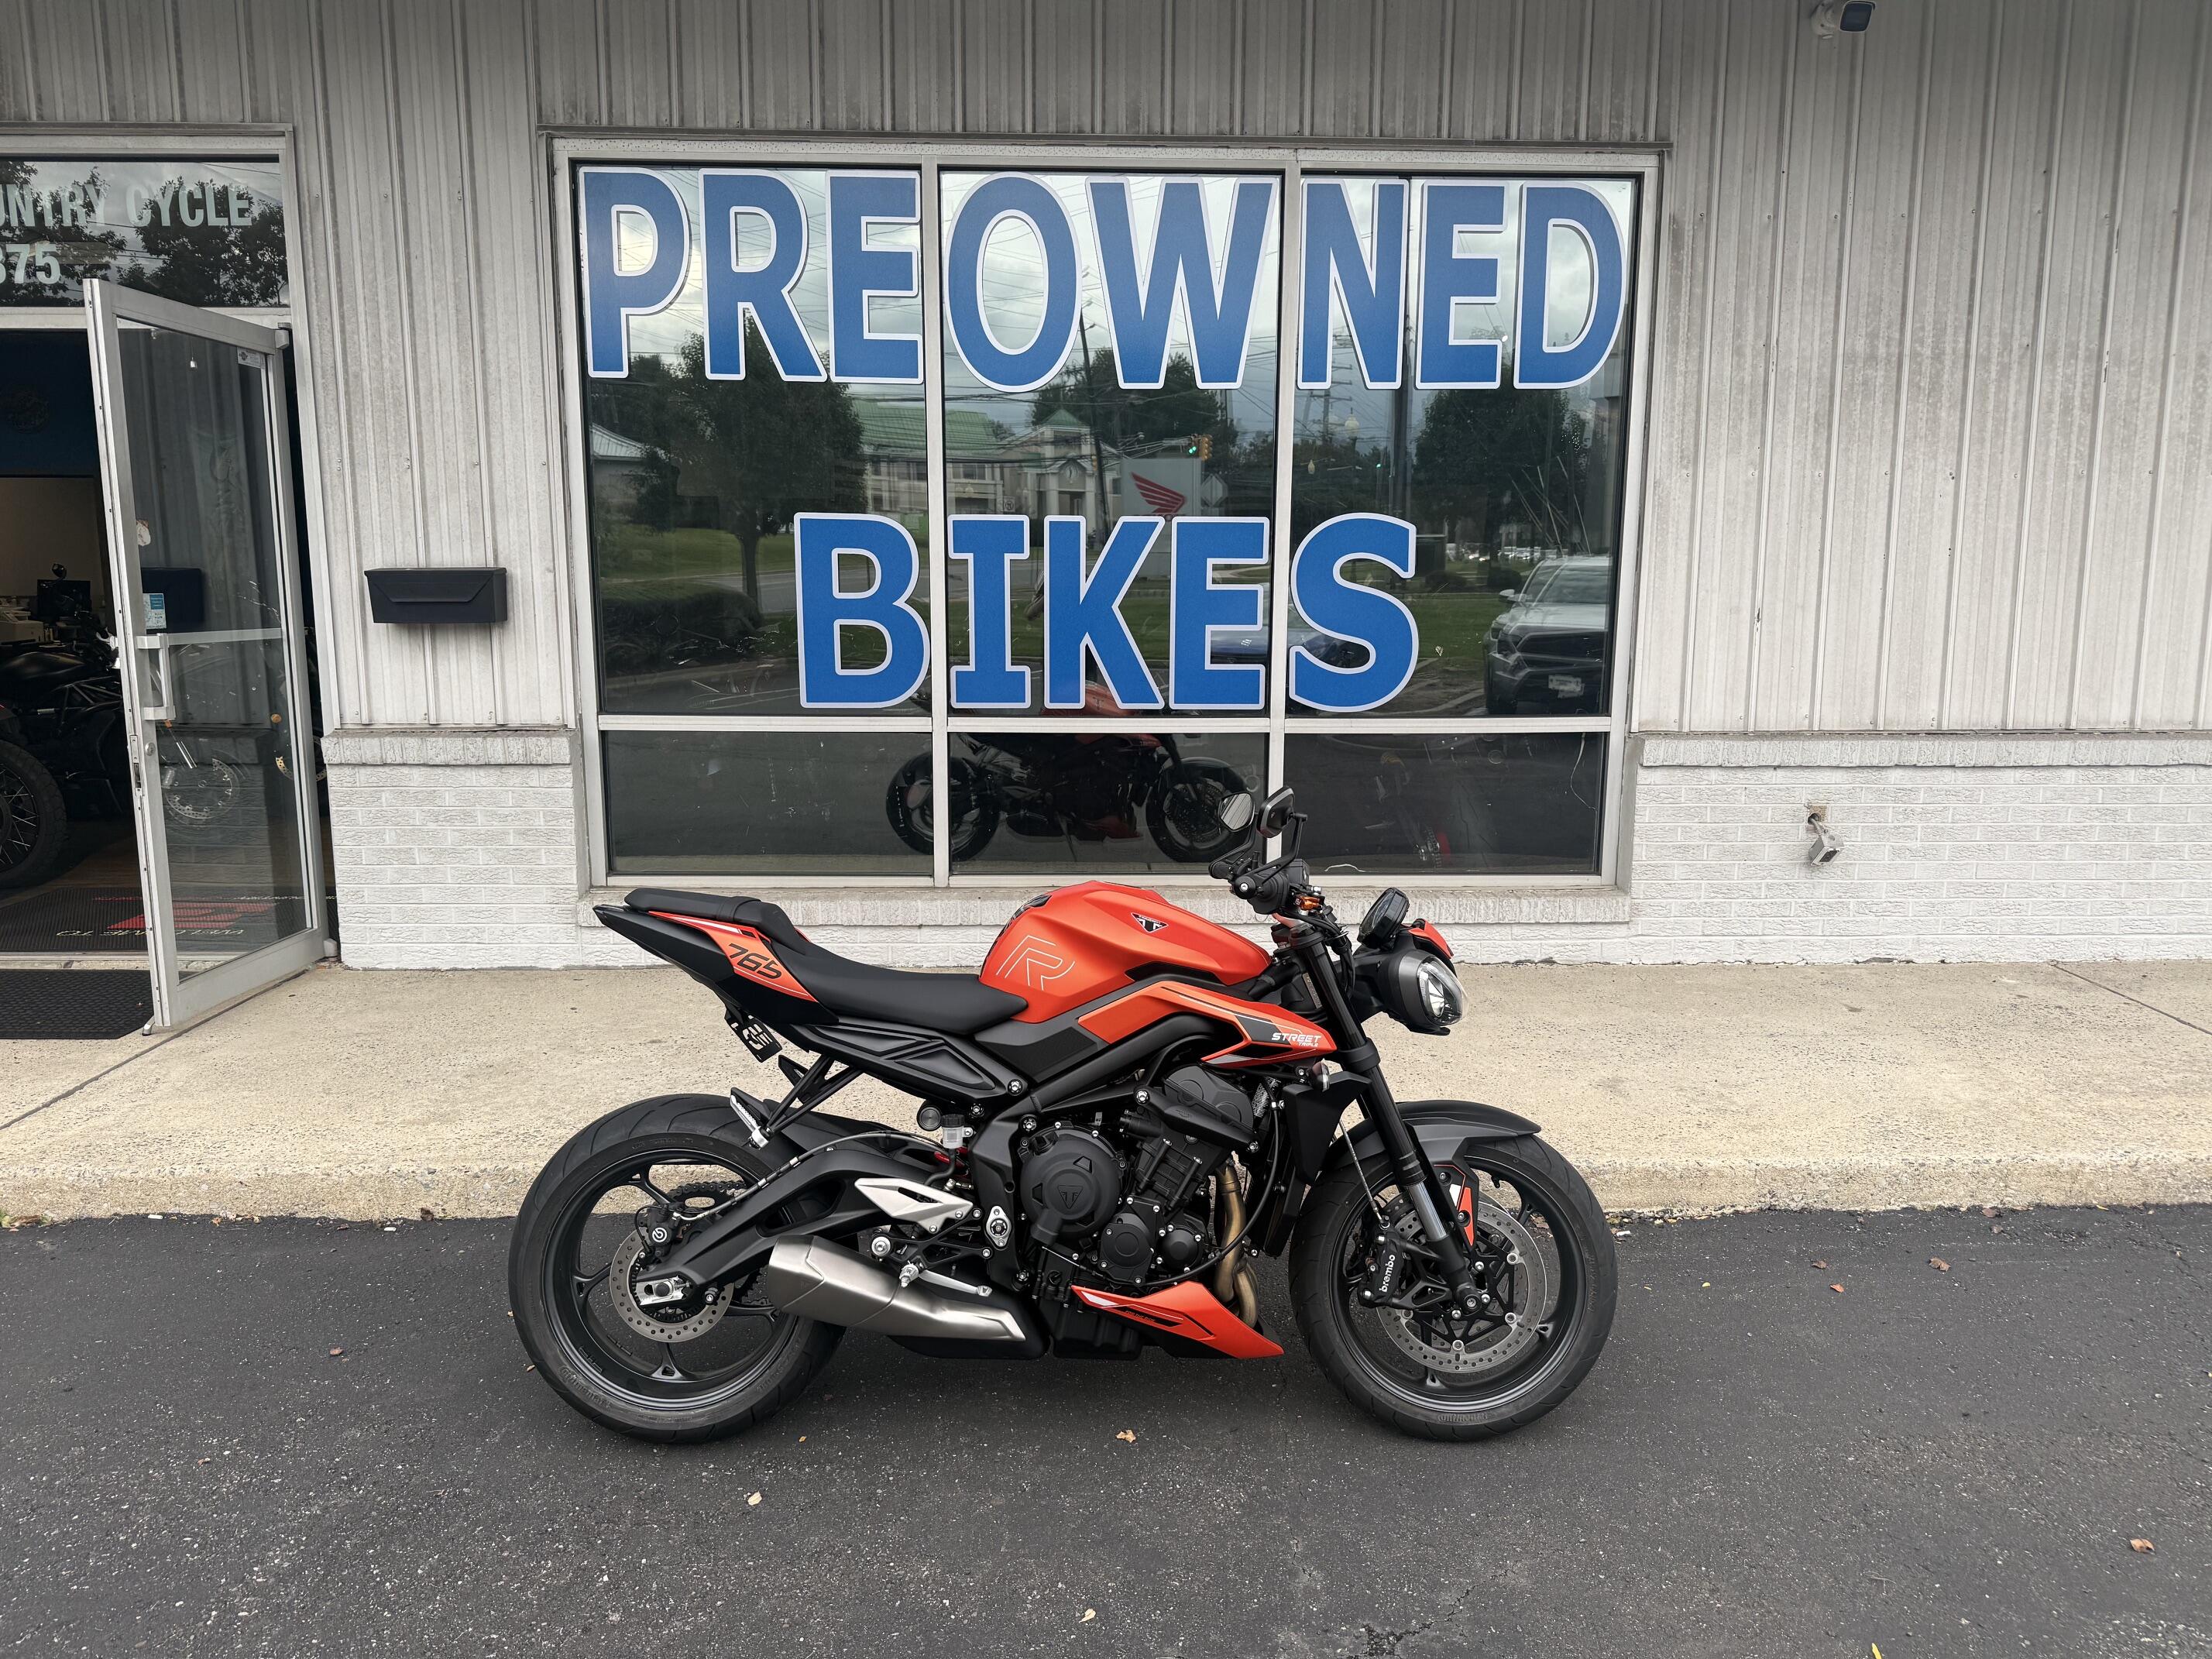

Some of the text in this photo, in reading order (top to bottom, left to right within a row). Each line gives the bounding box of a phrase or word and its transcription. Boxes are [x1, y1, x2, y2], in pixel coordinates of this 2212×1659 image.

[126, 183, 252, 227] CYCLE
[0, 243, 61, 284] 75
[579, 167, 1626, 393] PREOWNED
[794, 512, 1418, 713] BIKES
[728, 943, 782, 979] 765
[1271, 1032, 1321, 1043] STREET
[1379, 1254, 1396, 1293] brembo
